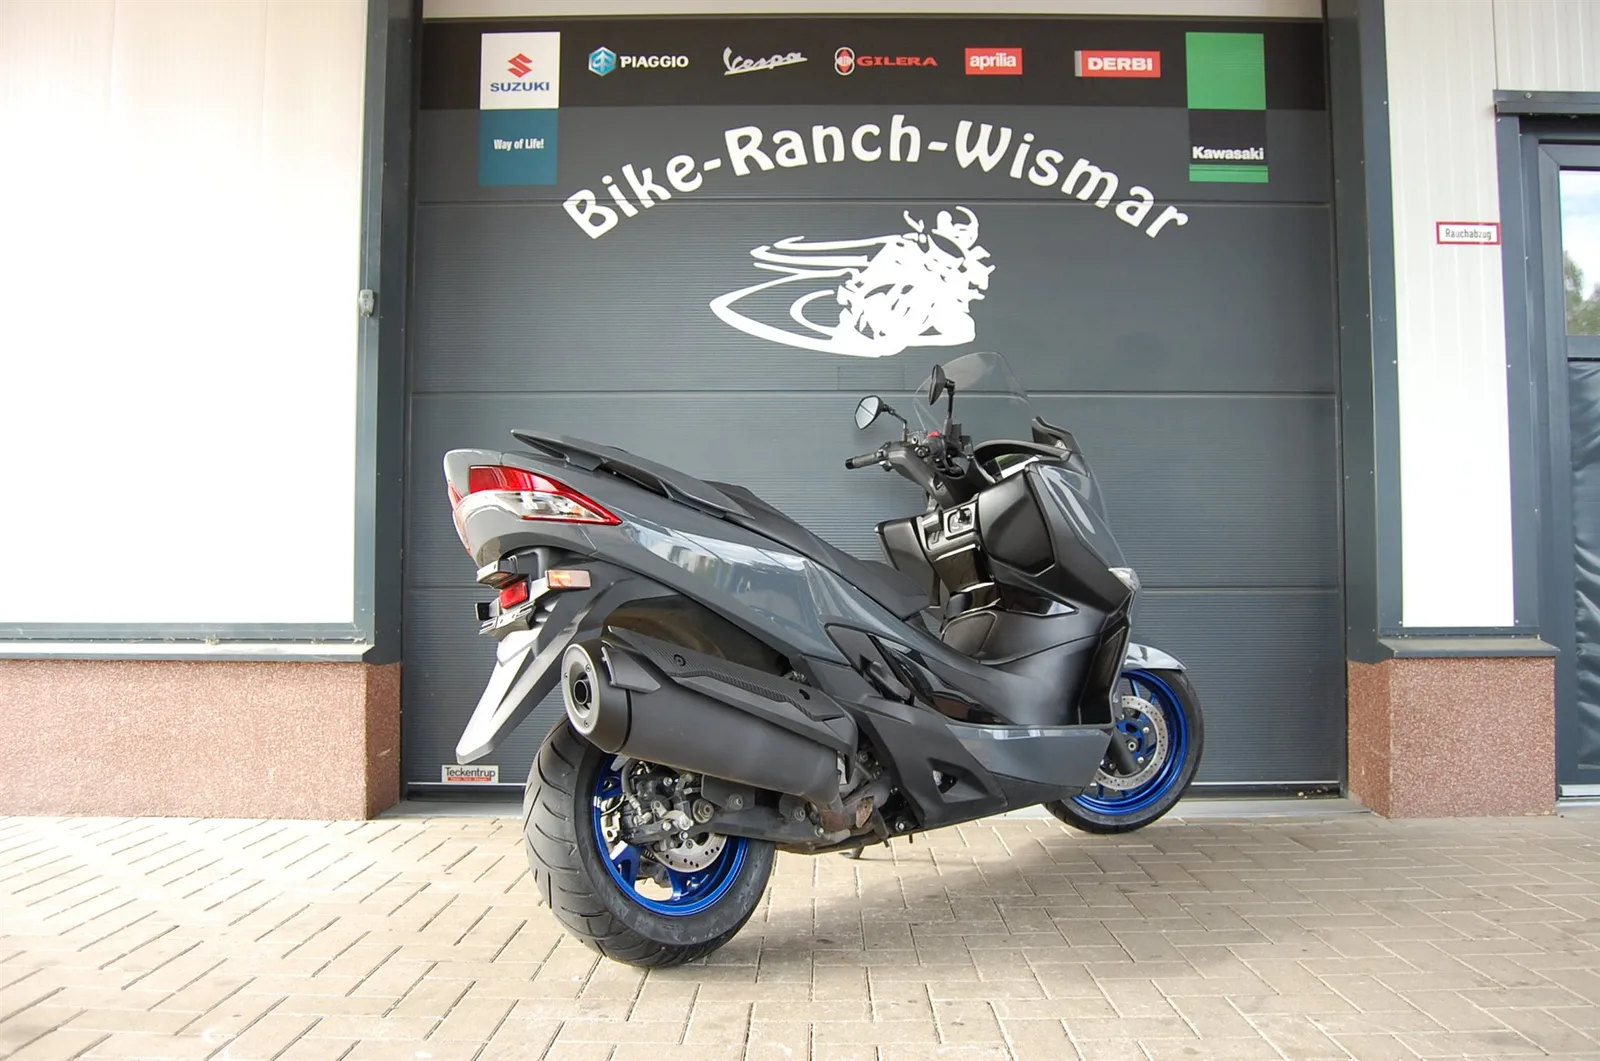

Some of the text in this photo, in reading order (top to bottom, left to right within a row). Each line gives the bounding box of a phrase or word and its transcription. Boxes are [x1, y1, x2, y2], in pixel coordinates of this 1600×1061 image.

[620, 55, 689, 69] PIAGGIO
[722, 47, 808, 76] Vespa
[857, 55, 938, 67] GILERA
[969, 53, 1017, 69] aprilia
[1087, 57, 1153, 71] DERBI
[490, 82, 550, 92] SUZUKI
[493, 138, 545, 151] Way of Life!
[1192, 146, 1264, 161] Kawasaki
[562, 114, 1188, 239] Bike-Ranch-Wismar
[1445, 228, 1492, 240] Rauchabzug
[445, 767, 496, 779] Teckentrup
